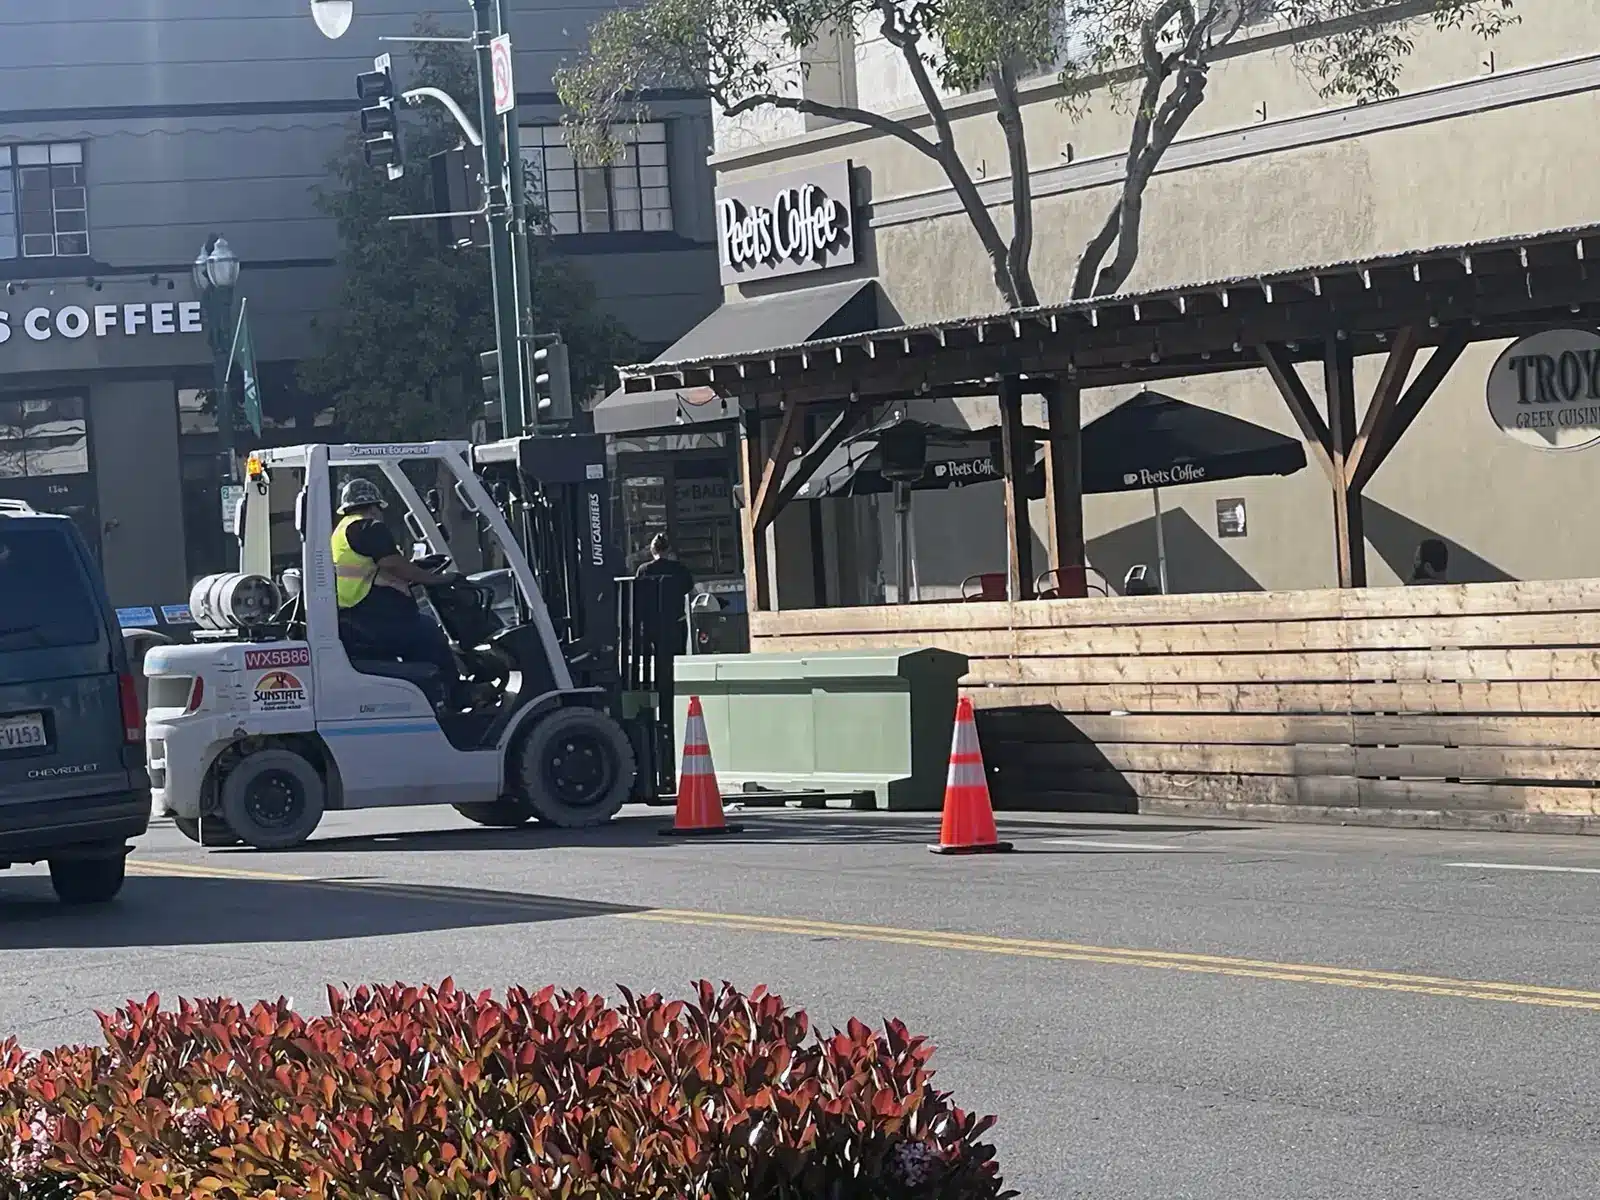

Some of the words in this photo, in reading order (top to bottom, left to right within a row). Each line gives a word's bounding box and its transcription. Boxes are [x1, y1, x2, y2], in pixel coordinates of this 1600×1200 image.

[716, 197, 772, 266] Peet's
[773, 183, 838, 261] Coffee
[24, 301, 203, 341] COFFEE
[1508, 348, 1600, 405] TROY
[1516, 410, 1555, 429] GREEK
[1557, 406, 1600, 426] CUISIN
[972, 458, 994, 475] Coff
[1170, 463, 1205, 482] Coffee
[589, 492, 604, 566] UNICARRIERS
[253, 690, 306, 702] SUNSTATE
[27, 763, 99, 779] CHEVROLET
